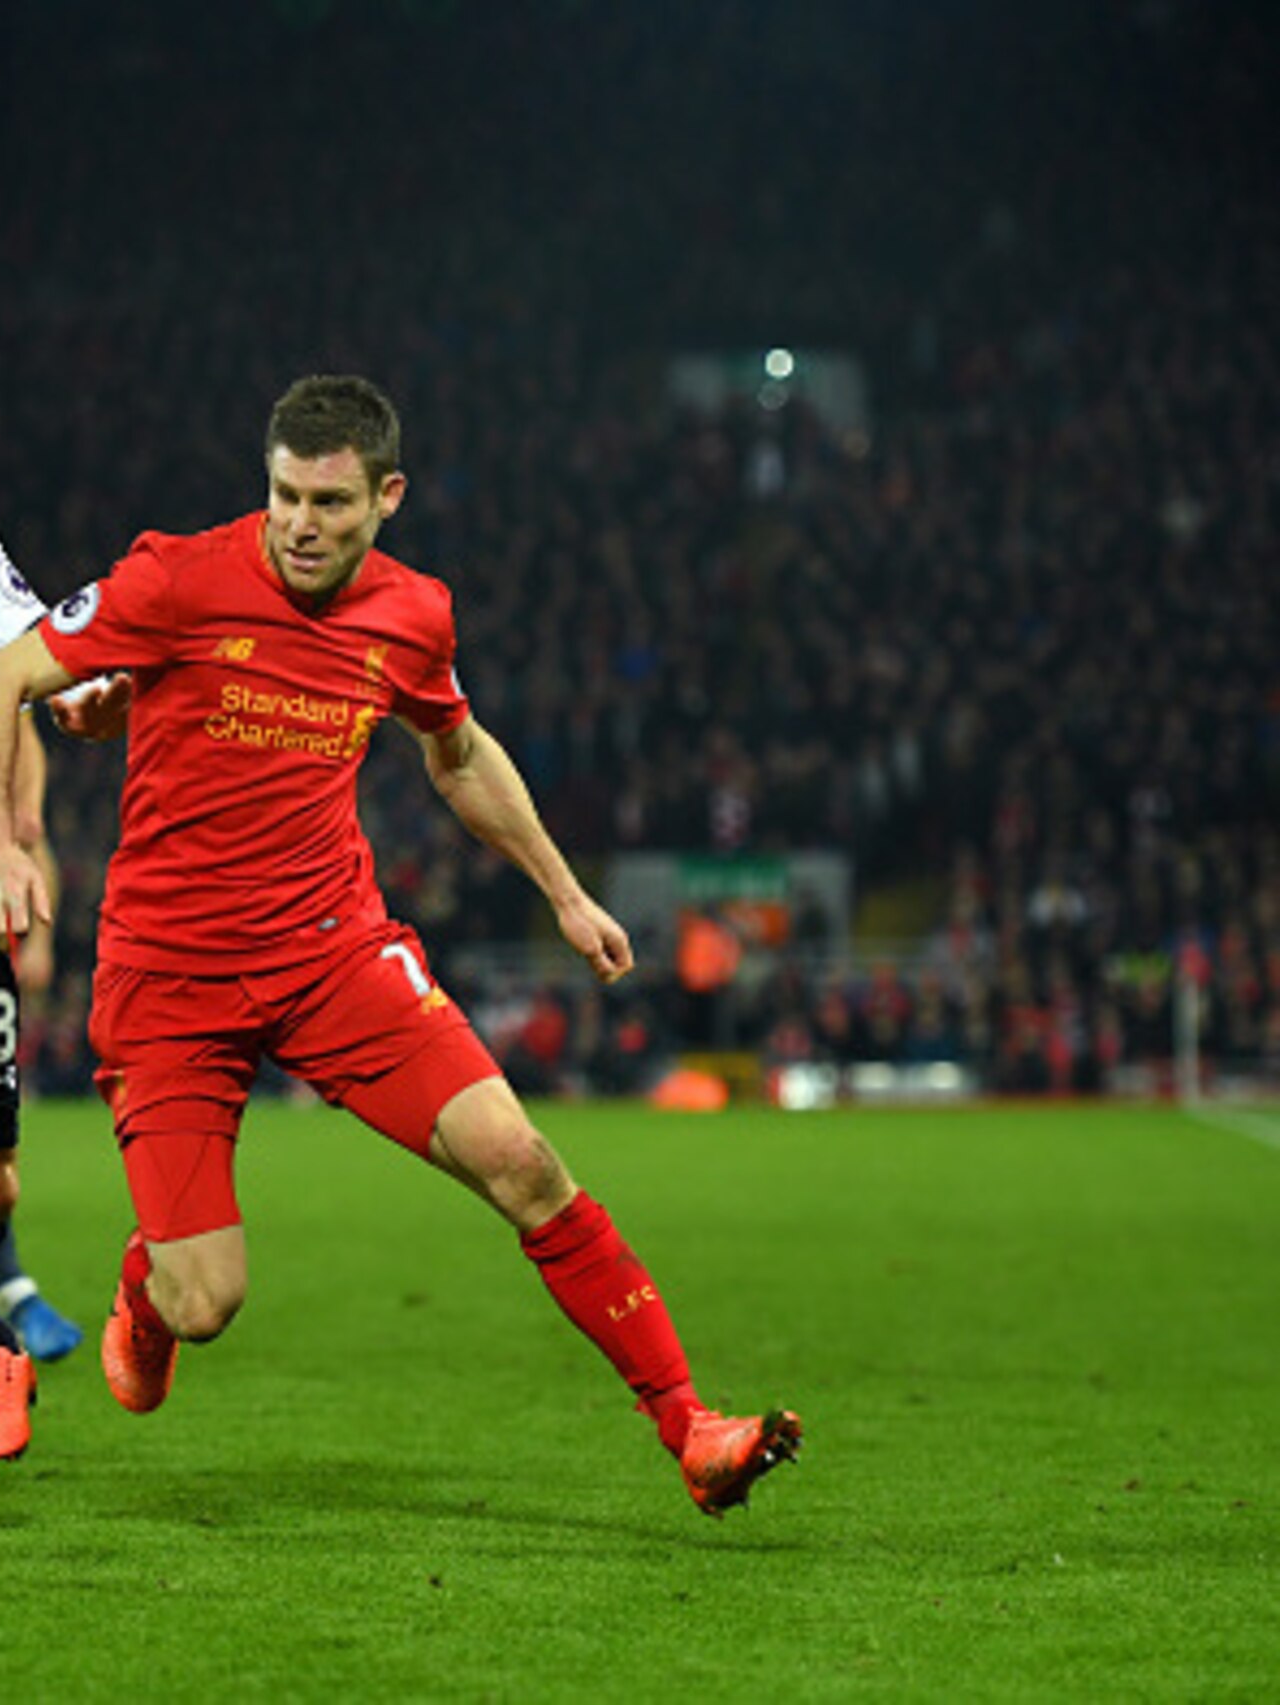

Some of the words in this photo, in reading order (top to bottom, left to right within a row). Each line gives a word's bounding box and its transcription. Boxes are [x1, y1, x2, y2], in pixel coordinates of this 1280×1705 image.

[221, 683, 348, 726] Standard
[204, 714, 344, 757] Chartered
[380, 942, 431, 996] 7
